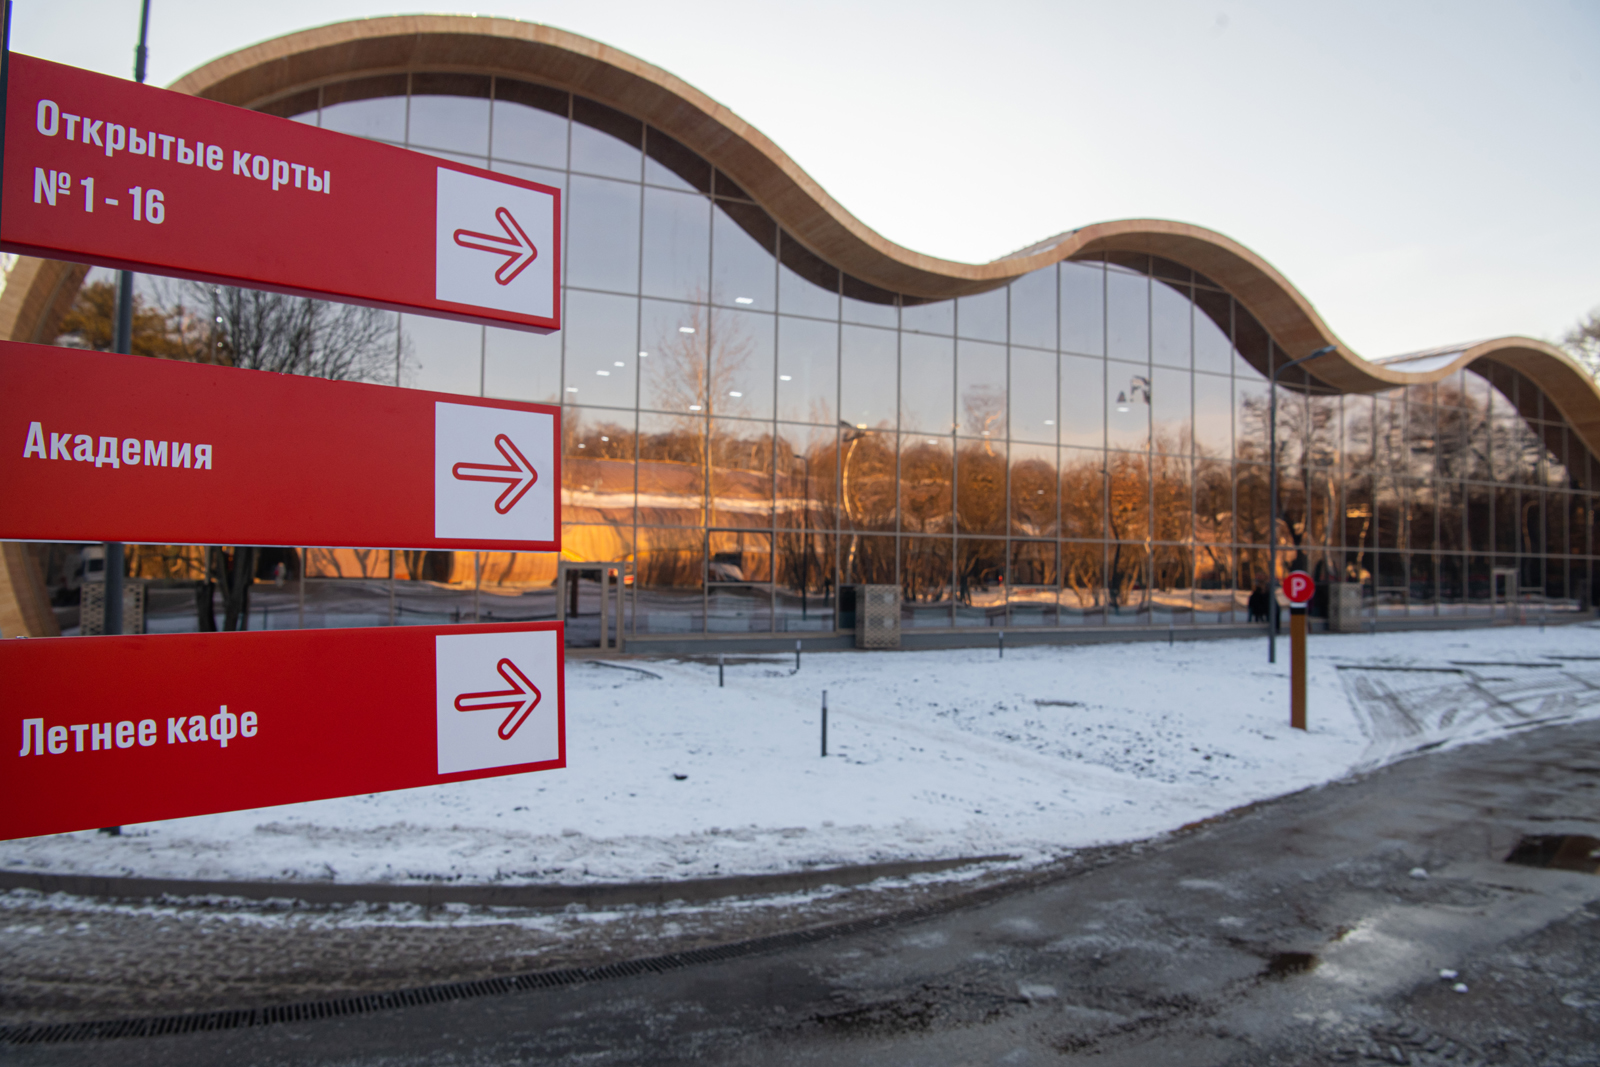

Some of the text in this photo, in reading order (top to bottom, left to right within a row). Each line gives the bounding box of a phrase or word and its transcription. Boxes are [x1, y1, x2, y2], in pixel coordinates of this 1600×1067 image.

[36, 99, 331, 195] Открытые корты
[80, 177, 95, 213] 1
[128, 186, 165, 225] 16
[23, 421, 213, 470] Академия
[1290, 576, 1307, 599] P
[19, 704, 258, 757] Летнее кафе
